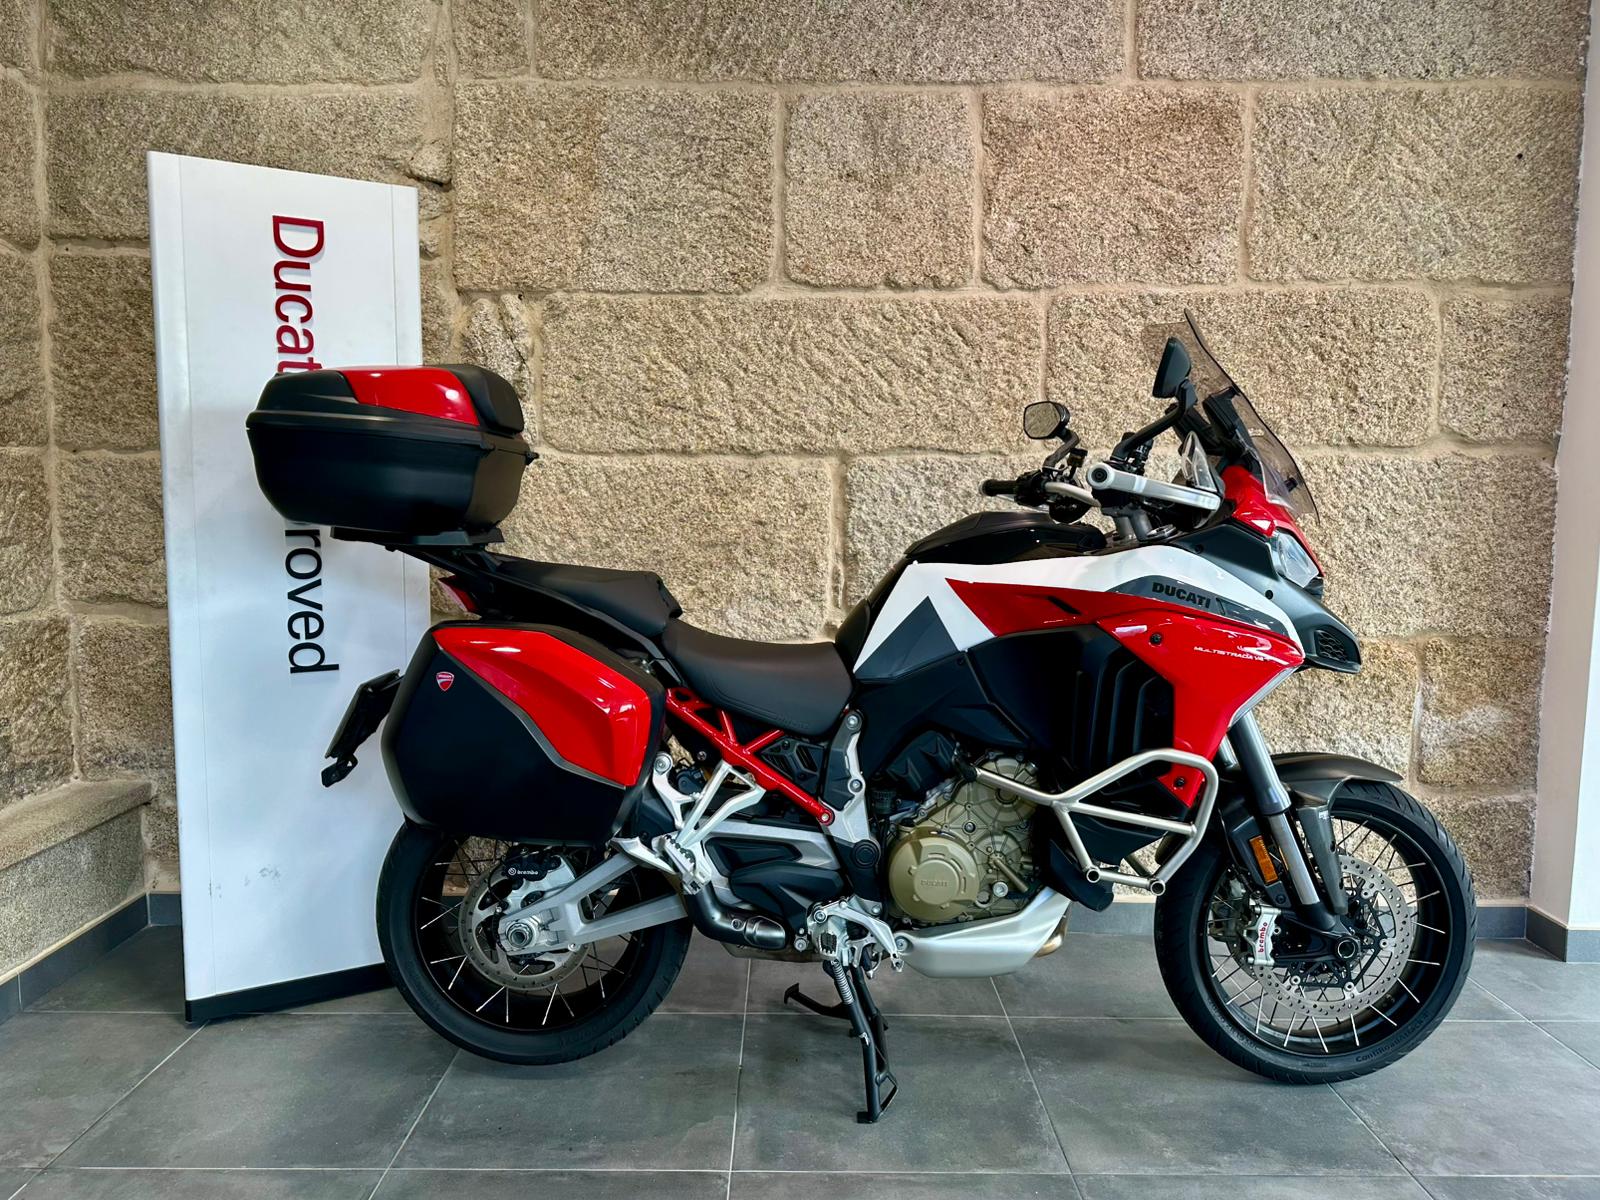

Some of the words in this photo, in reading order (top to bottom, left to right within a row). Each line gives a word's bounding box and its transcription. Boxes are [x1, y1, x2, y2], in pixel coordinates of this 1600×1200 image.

[272, 215, 324, 373] Ducat
[285, 529, 340, 674] roved
[1152, 582, 1211, 609] DUCATI
[1193, 646, 1254, 660] MULTISTRADA
[1257, 922, 1268, 953] brembo
